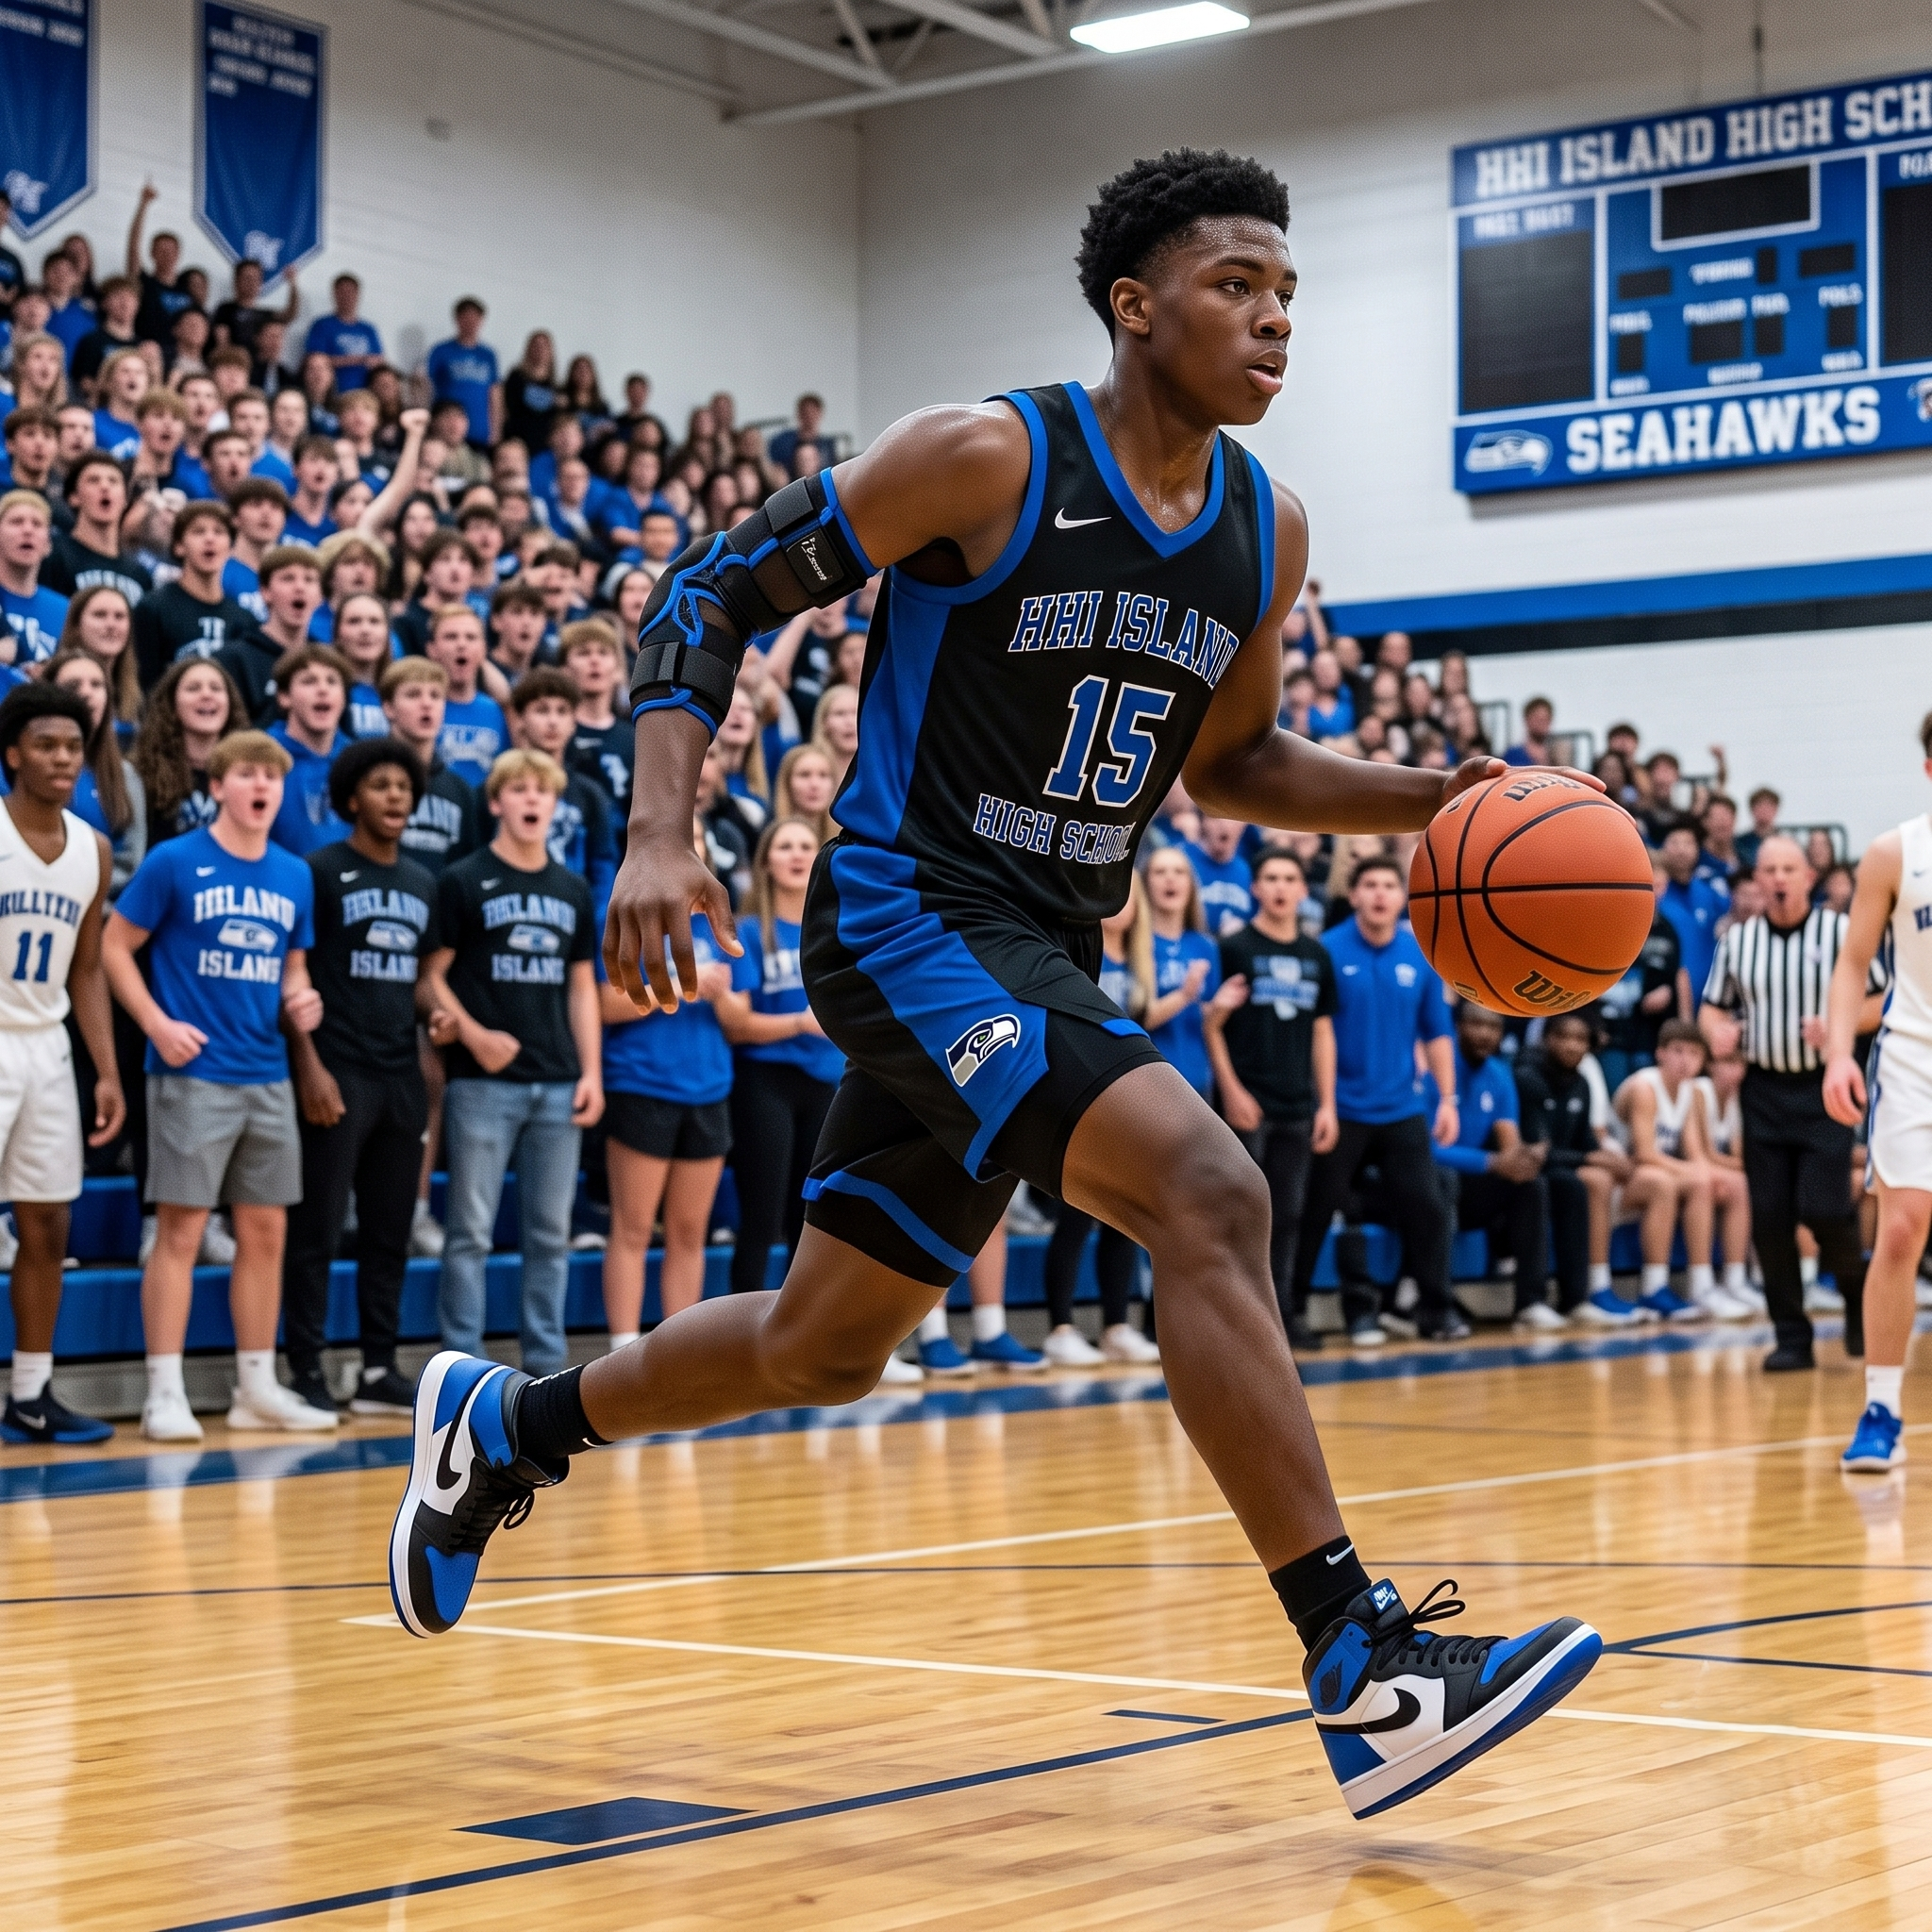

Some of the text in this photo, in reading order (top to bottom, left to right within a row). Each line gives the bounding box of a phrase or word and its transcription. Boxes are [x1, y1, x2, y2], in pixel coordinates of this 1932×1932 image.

[1476, 141, 1549, 199] HHI
[1560, 116, 1715, 185] ISLAND
[1725, 96, 1833, 159] HIGH
[1566, 385, 1881, 474] SEAHAWKS
[1008, 591, 1240, 691] HHI ISLAND
[1042, 675, 1176, 808] 15
[973, 792, 1057, 855] HIGH
[11, 930, 53, 983] 11
